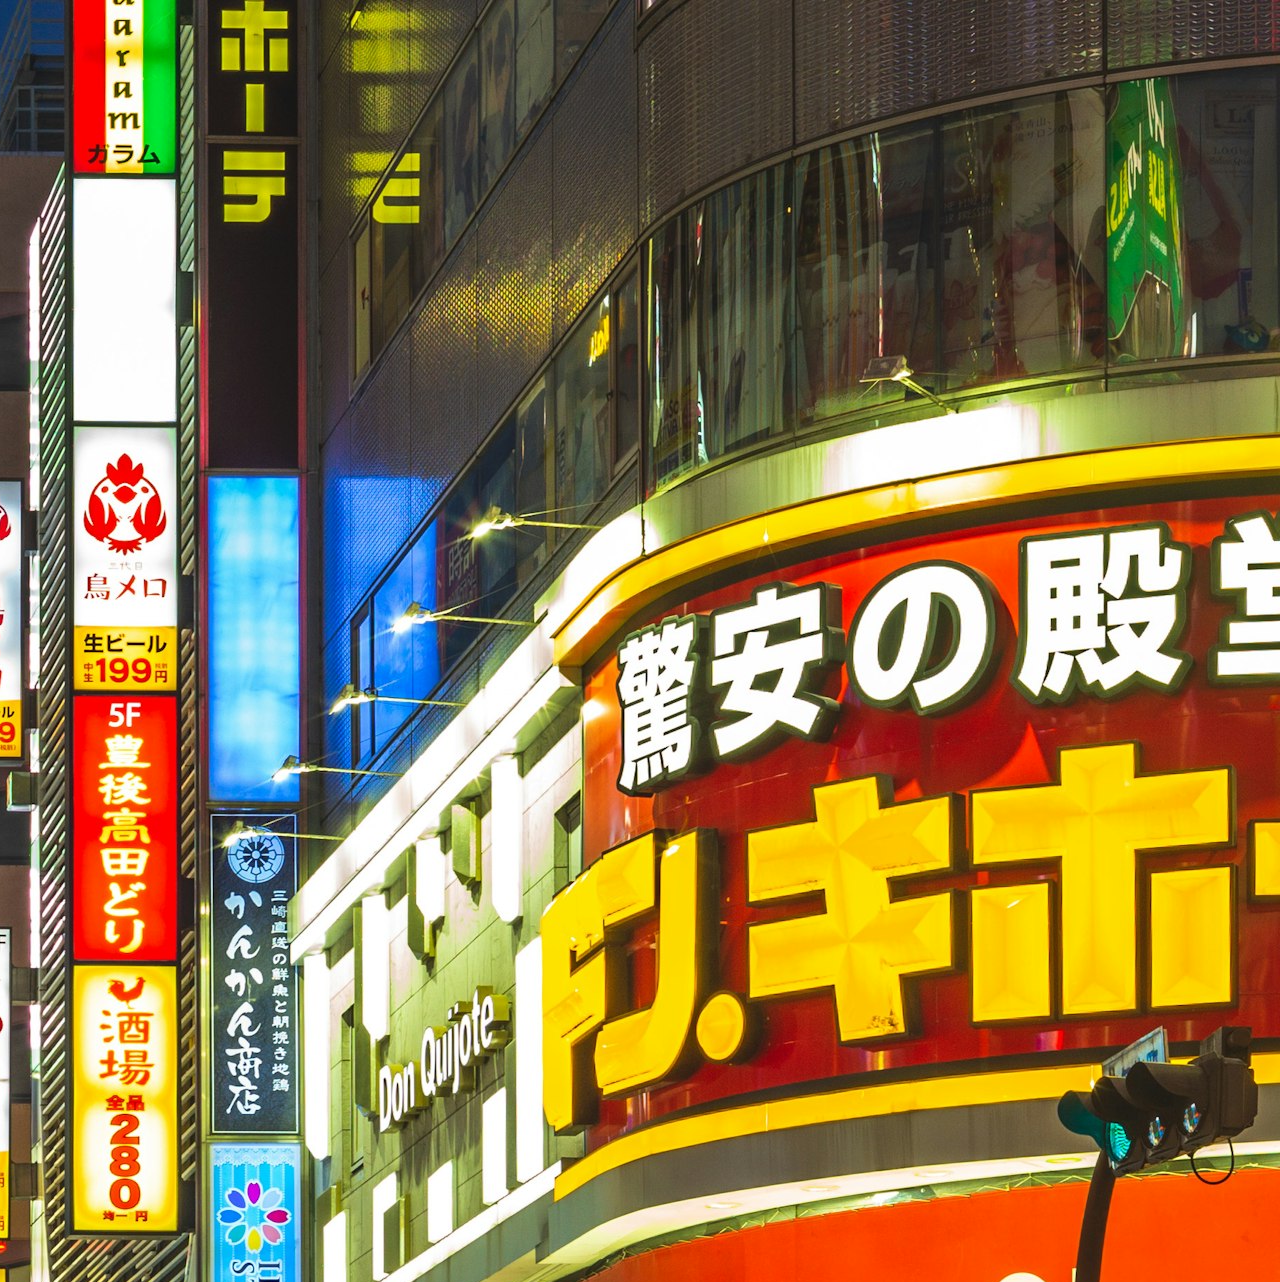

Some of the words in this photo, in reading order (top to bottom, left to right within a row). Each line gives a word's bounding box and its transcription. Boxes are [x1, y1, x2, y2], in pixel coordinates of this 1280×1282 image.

[88, 143, 161, 165] ガラム
[83, 573, 168, 600] 鳥メロ
[82, 634, 168, 654] 生ビール
[108, 703, 142, 728] 5F
[224, 888, 264, 1116] かんかん商店
[98, 1009, 155, 1087] 酒場
[378, 1058, 417, 1134] Don
[419, 990, 497, 1106] Quijote
[108, 1113, 142, 1210] 280
